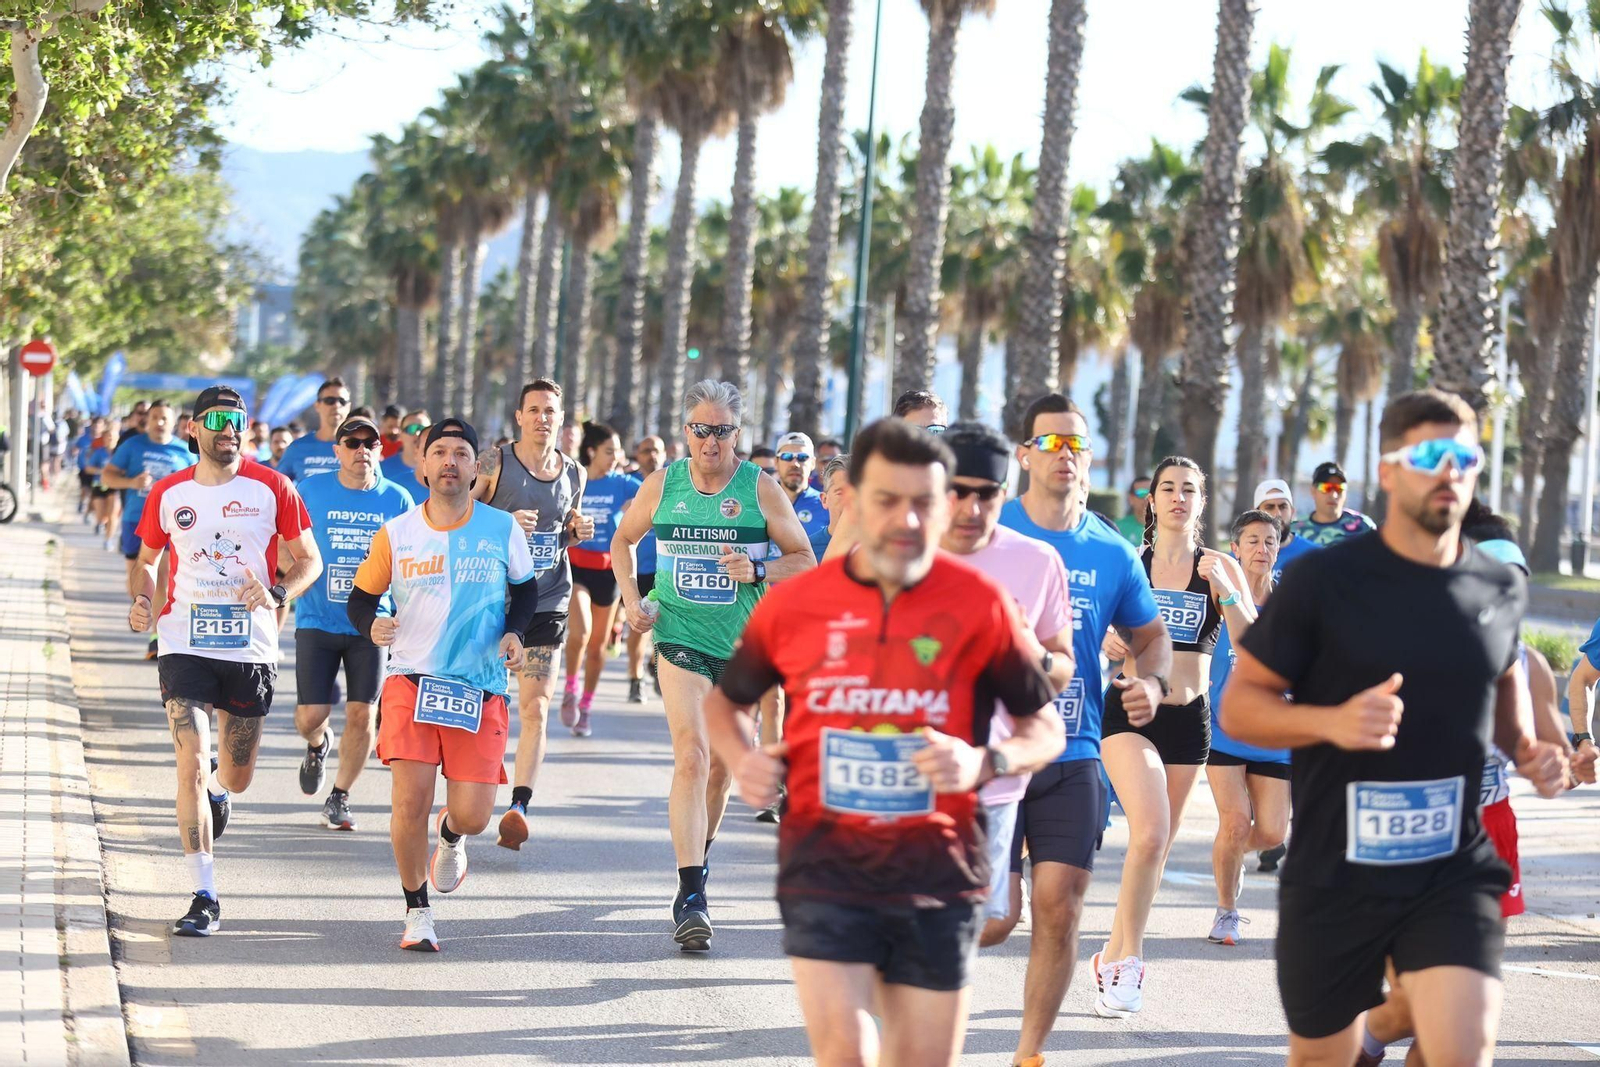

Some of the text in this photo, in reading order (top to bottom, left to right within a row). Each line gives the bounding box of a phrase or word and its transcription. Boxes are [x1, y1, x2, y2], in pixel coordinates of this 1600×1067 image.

[327, 510, 384, 523] mayoral
[672, 527, 738, 540] ATLETISMO
[664, 543, 748, 555] TORREMOLOS
[399, 554, 445, 579] Trail
[454, 556, 500, 570] MONTE
[428, 575, 445, 586] 2022
[454, 569, 501, 584] HACHO
[681, 574, 730, 589] 2160
[196, 620, 244, 634] 2151
[425, 694, 475, 716] 2150
[837, 764, 921, 787] 1682
[1367, 811, 1446, 836] 1828
